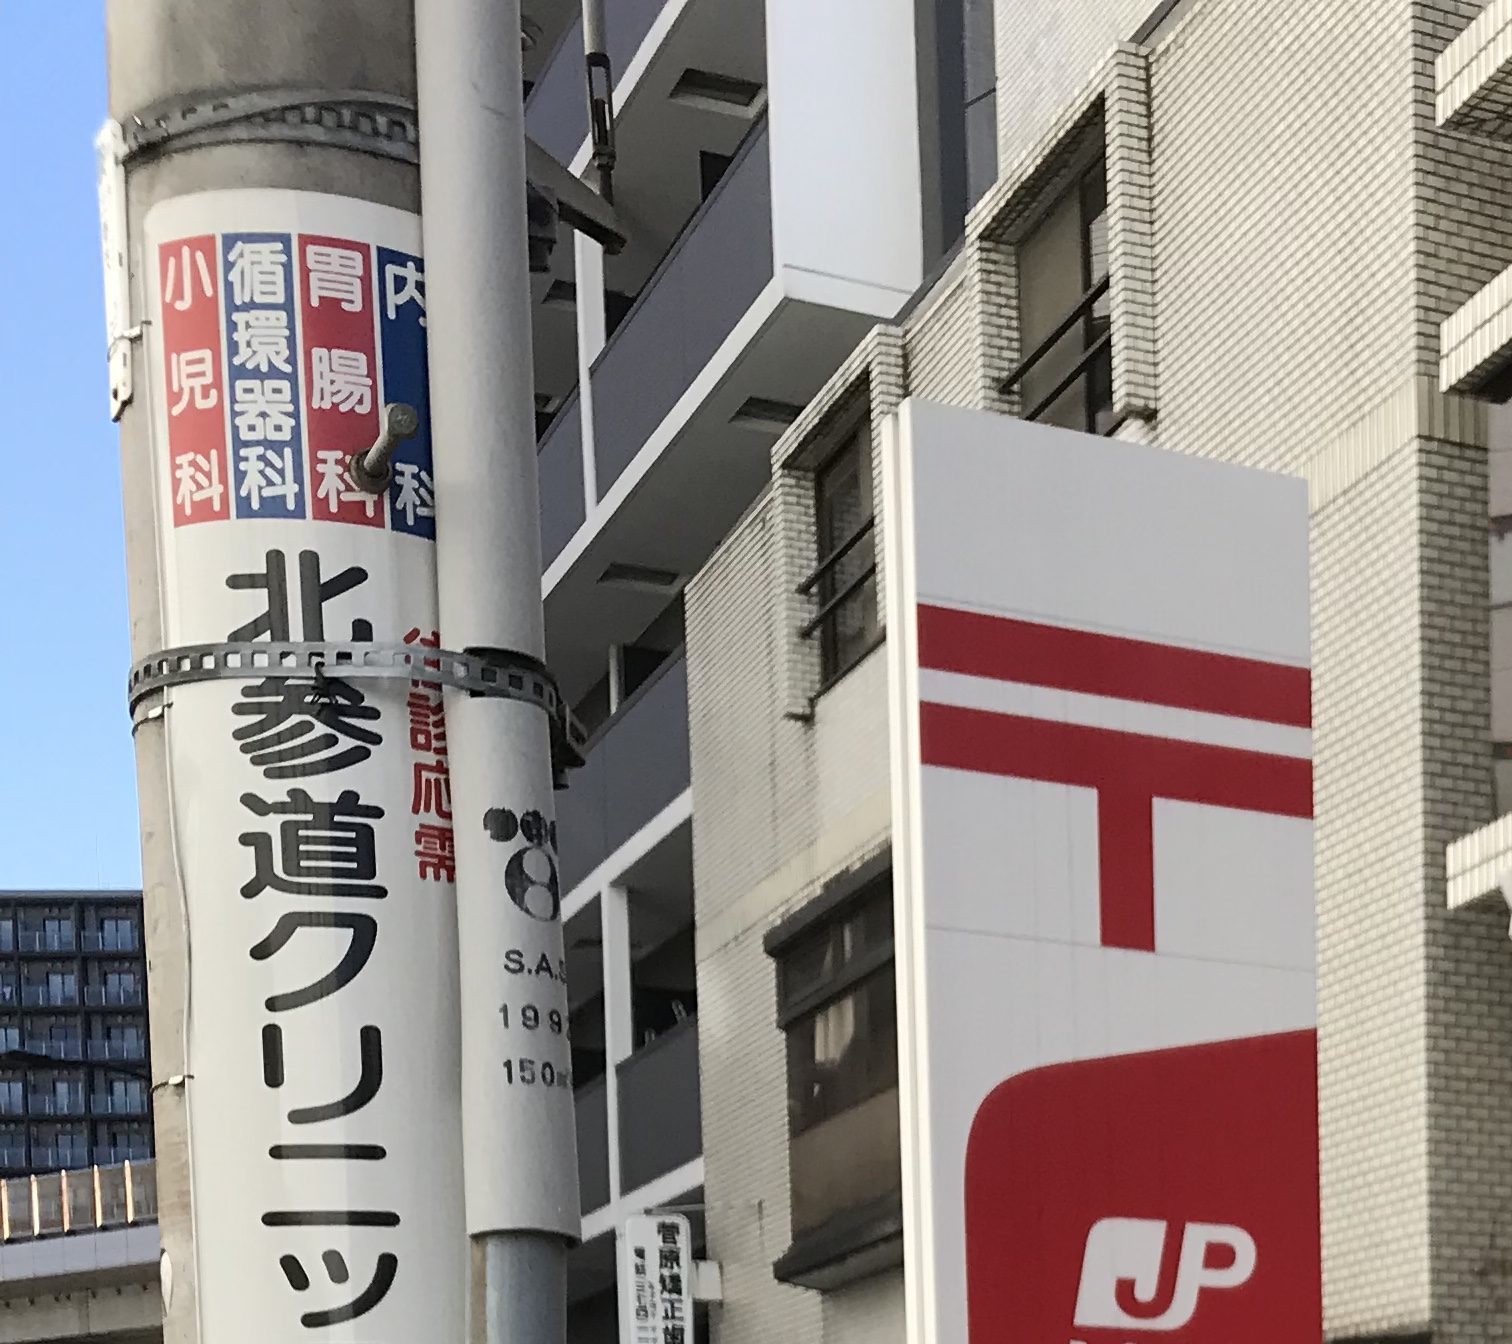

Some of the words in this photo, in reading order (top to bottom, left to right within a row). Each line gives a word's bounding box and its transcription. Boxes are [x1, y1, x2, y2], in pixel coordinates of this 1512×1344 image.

[165, 245, 220, 517] 小児科
[227, 241, 299, 511] 循環器科
[306, 245, 382, 518] 胃腸科
